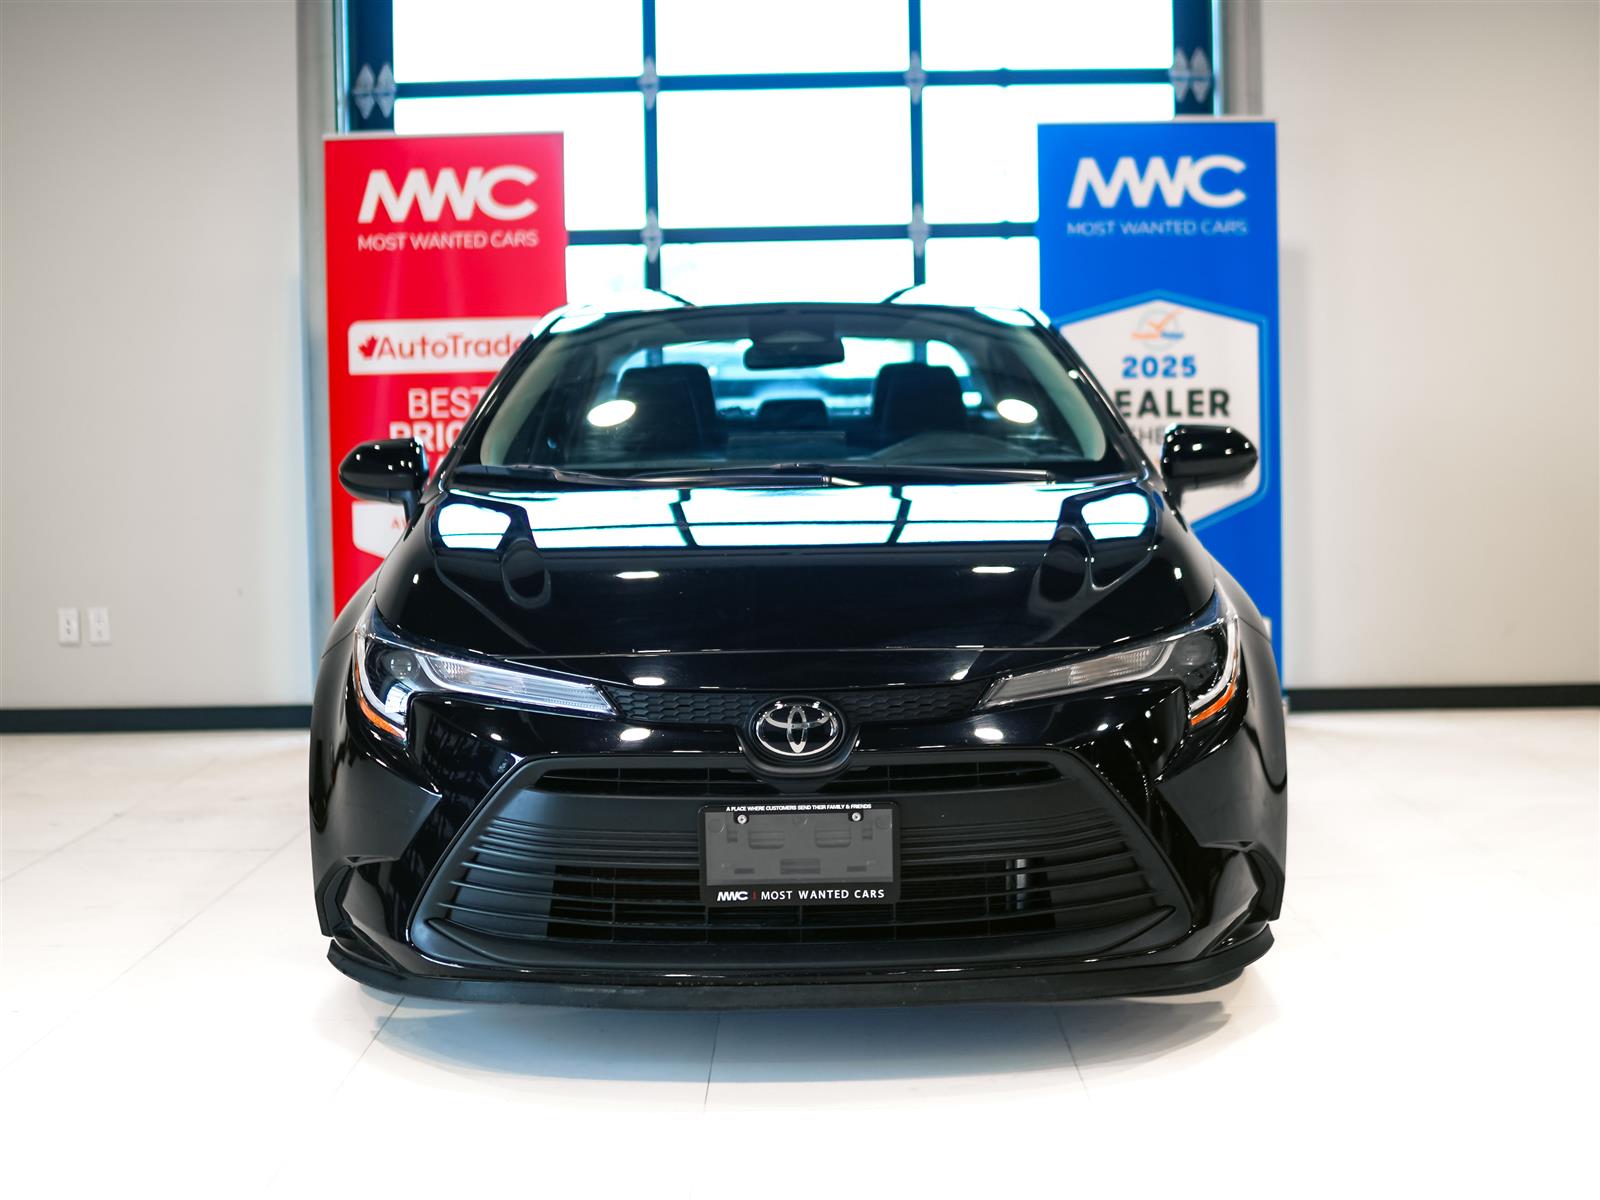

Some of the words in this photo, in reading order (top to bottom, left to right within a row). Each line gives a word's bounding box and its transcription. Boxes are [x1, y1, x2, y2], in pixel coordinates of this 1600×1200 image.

[1067, 154, 1247, 208] MWC
[357, 164, 539, 224] MWC
[1066, 220, 1116, 236] MOST
[1120, 219, 1197, 235] WANTED
[1200, 218, 1248, 235] CARS
[357, 232, 405, 252] MOST
[409, 231, 487, 250] WANTED
[489, 229, 539, 248] CARS
[1121, 355, 1198, 379] 2025
[1114, 388, 1231, 418] EALER
[716, 891, 749, 901] MWC
[760, 891, 793, 900] MOST
[799, 890, 849, 900] WANTED
[854, 889, 885, 899] CARS
